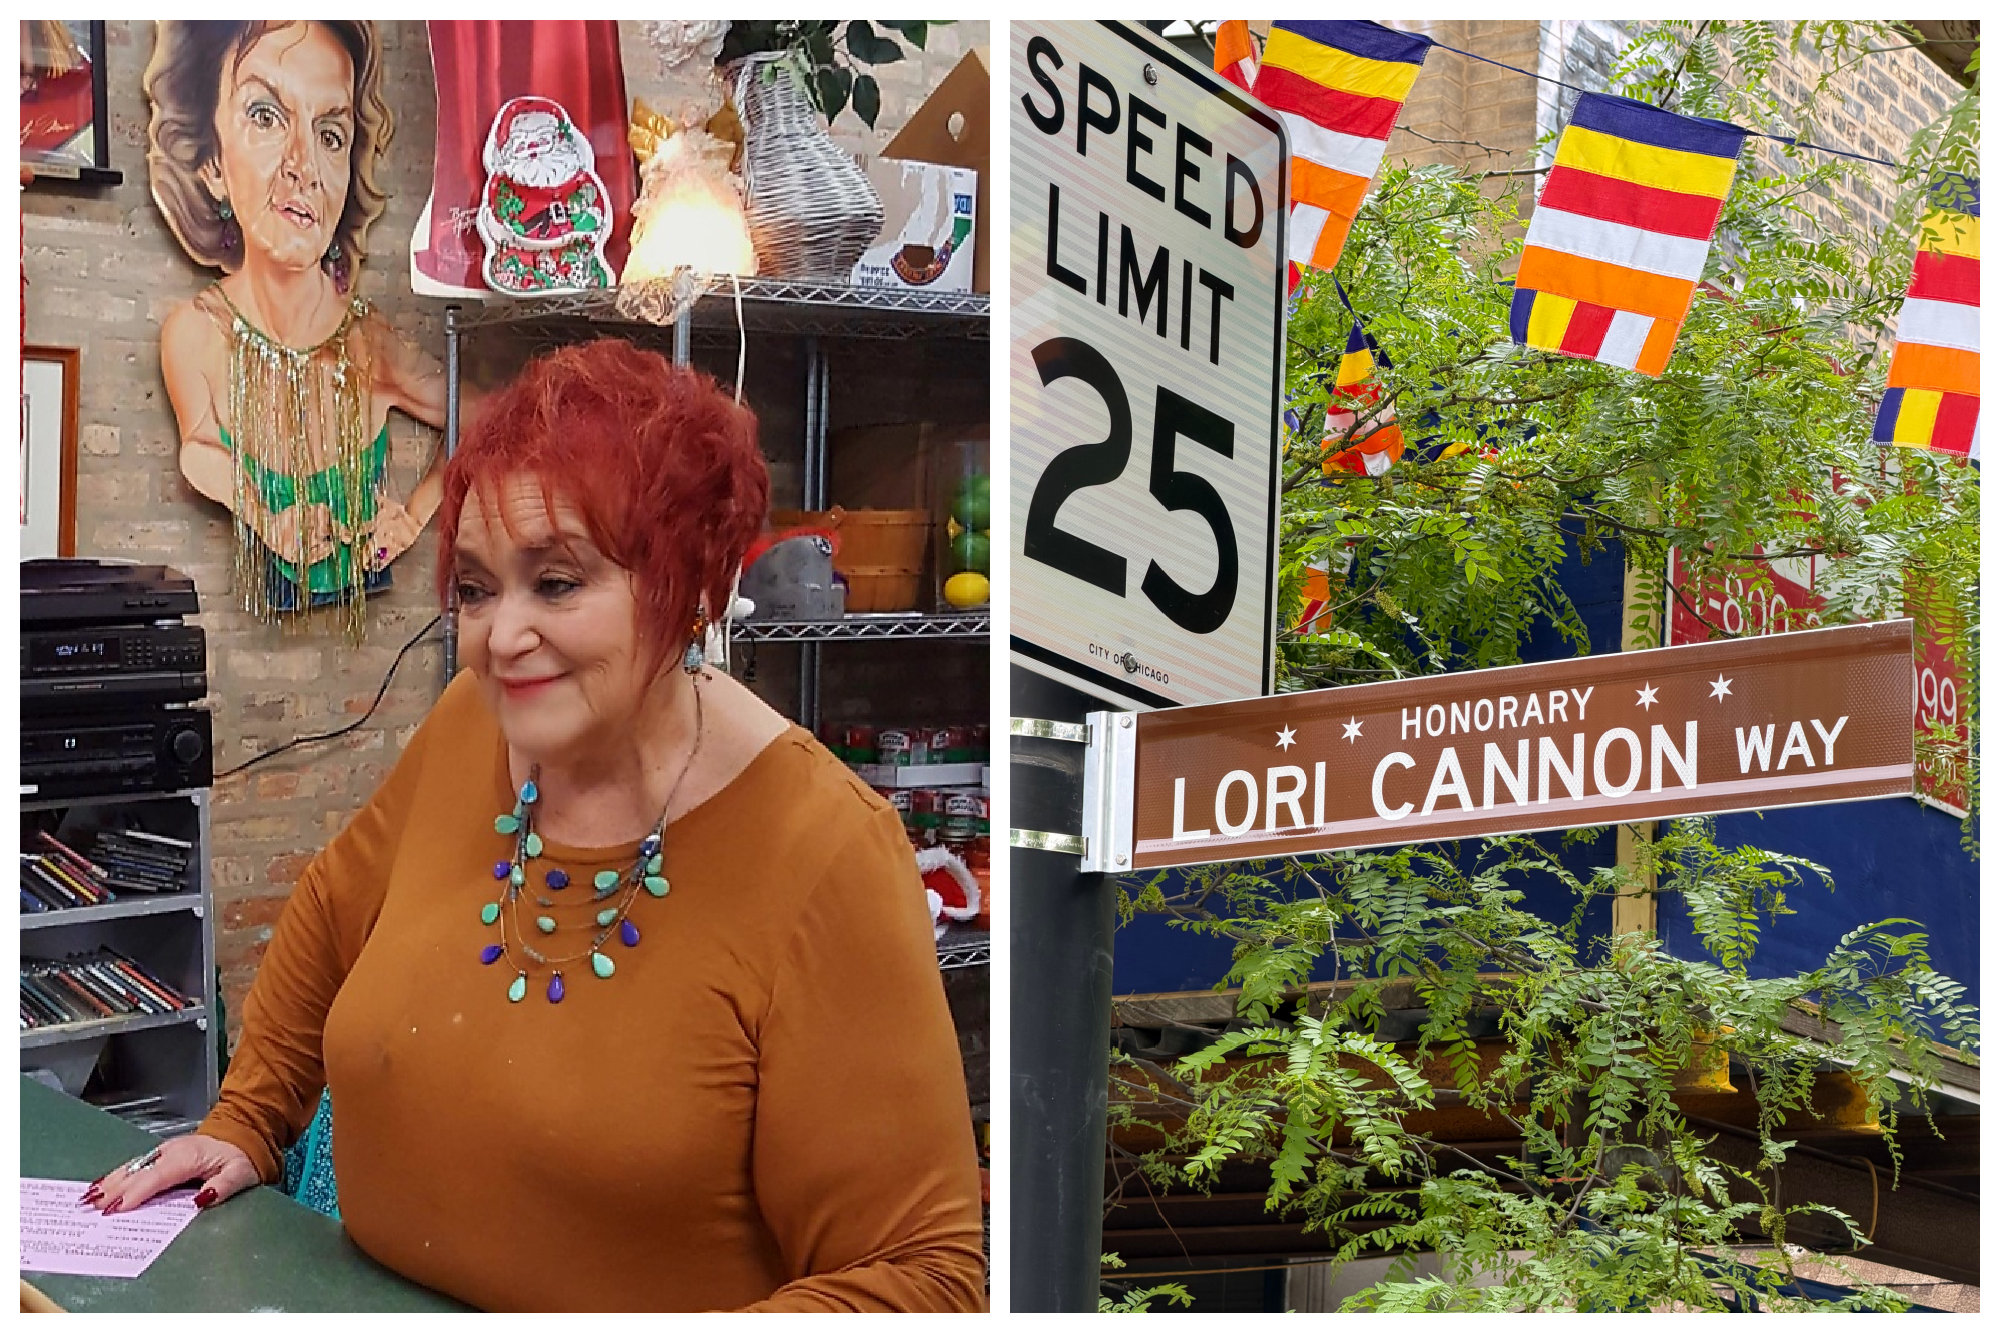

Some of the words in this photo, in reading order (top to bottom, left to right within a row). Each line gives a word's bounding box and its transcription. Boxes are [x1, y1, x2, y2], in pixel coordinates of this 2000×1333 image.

[1021, 36, 1264, 248] SPEED
[1047, 182, 1234, 366] LIMIT
[1024, 337, 1239, 634] 25
[1089, 643, 1109, 660] CITY
[1135, 662, 1169, 684] HICAGO
[1401, 686, 1594, 740] HONORARY
[1172, 761, 1326, 842] LORI
[1371, 720, 1698, 821] CANNON
[1735, 716, 1850, 774] WAY
